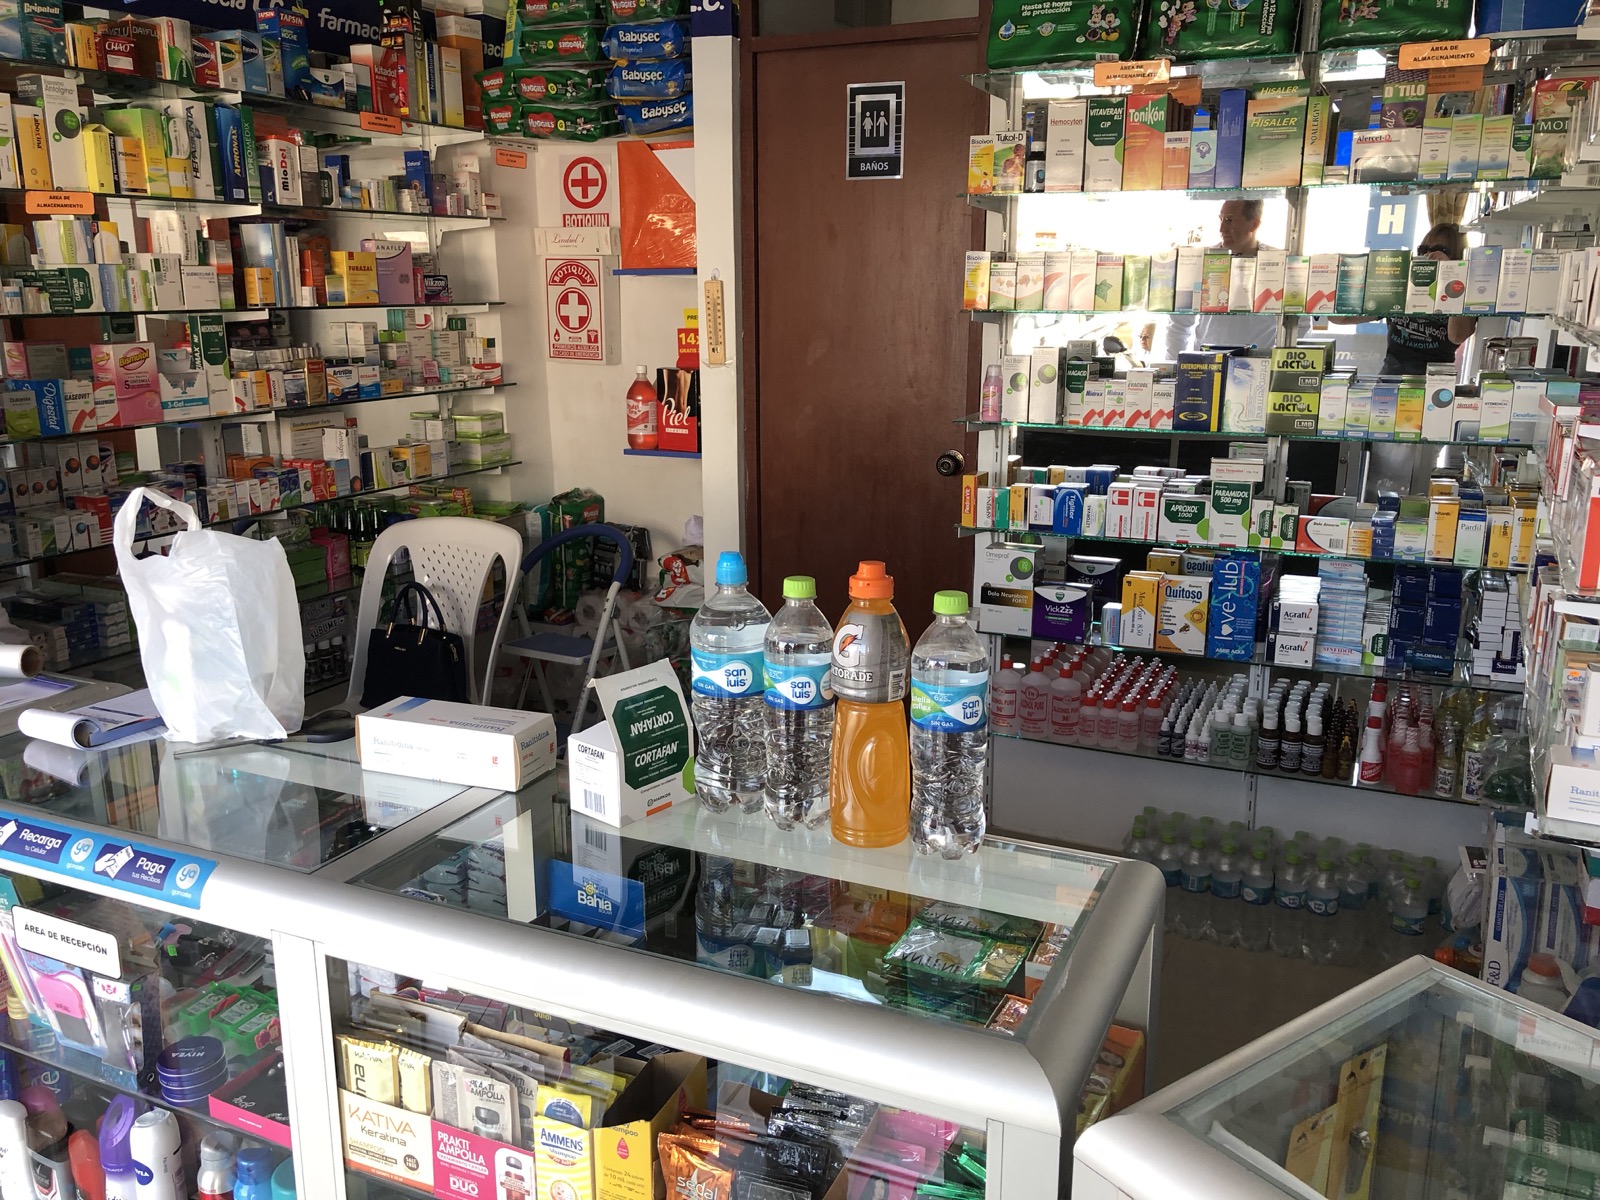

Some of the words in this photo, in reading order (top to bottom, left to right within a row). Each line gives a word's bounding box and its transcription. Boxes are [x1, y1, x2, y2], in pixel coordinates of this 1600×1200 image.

[525, 2, 548, 12] HUGGIES
[611, 0, 637, 9] HUGGIES
[1022, 3, 1041, 11] Hasta
[1052, 0, 1073, 9] horas
[1031, 7, 1071, 17] protección
[279, 12, 304, 26] TAPSIN
[619, 30, 661, 44] Babysec
[1413, 53, 1476, 62] ALMACENAMIENTO
[374, 64, 397, 78] kitadol
[622, 70, 663, 83] Babysec
[482, 77, 504, 88] HUGGIES
[521, 83, 547, 94] HUGGIES
[1260, 85, 1299, 96] HISALER
[490, 110, 512, 120] HUGGIES
[641, 100, 688, 120] Babysec
[1090, 107, 1123, 117] VITAVERAN
[528, 118, 555, 130] HUGGIES
[1051, 118, 1083, 127] Hemocyton
[1100, 121, 1112, 129] CIP
[1250, 117, 1298, 128] HISALER
[995, 133, 1024, 142] Tukol-D
[232, 127, 242, 177] APRONAX
[859, 161, 889, 172] BAÑOS
[565, 214, 608, 228] BOTIQUIN
[1375, 255, 1403, 263] Azimut
[348, 265, 373, 273] FURAZAL
[553, 265, 593, 284] BOTIQUIN
[118, 350, 150, 368] Bismutol
[1286, 351, 1307, 361] BIO
[1277, 360, 1317, 372] LACTOL
[65, 392, 91, 401] GASEOVET
[1282, 394, 1303, 403] BIO
[663, 397, 691, 427] Piel
[1273, 402, 1313, 413] LACTOL
[1214, 489, 1249, 498] PARAMIDOL
[1170, 505, 1199, 513] APROXOL
[1001, 592, 1029, 600] Neurobion
[1165, 585, 1203, 600] Quitoso
[1011, 597, 1028, 605] FORTE
[1045, 604, 1074, 614] VickZzz
[1283, 607, 1313, 620] Agrafil
[1279, 640, 1309, 652] Agrafil
[724, 669, 747, 677] san
[726, 677, 747, 688] luis
[790, 681, 811, 689] san
[792, 688, 811, 699] luis
[962, 699, 980, 710] san
[963, 708, 979, 720] luis
[630, 710, 675, 737] CORTAFAN
[520, 730, 550, 751] Ranitidina
[577, 743, 605, 760] CORTAFAN
[634, 742, 679, 768] CORTAFAN
[19, 828, 62, 849] Recarga
[31, 845, 48, 856] Celular
[73, 841, 91, 857] ya
[136, 857, 166, 875] Paga
[141, 873, 162, 884] Recibos
[181, 867, 197, 882] ya
[577, 889, 613, 913] Bahía
[24, 922, 46, 938] ÁREA
[47, 929, 59, 941] DE
[60, 934, 108, 957] RECEPCIÓN
[1487, 959, 1501, 987] F&D
[171, 1050, 206, 1059] NIVEA
[469, 1087, 506, 1102] AMPOLLA
[348, 1103, 417, 1139] KATIVA
[360, 1124, 408, 1148] Keratina
[437, 1130, 470, 1150] PRAKTI
[540, 1127, 583, 1152] AMMENS
[438, 1144, 486, 1166] AMPOLLA
[450, 1176, 479, 1195] DUO
[677, 1176, 718, 1200] sedal
